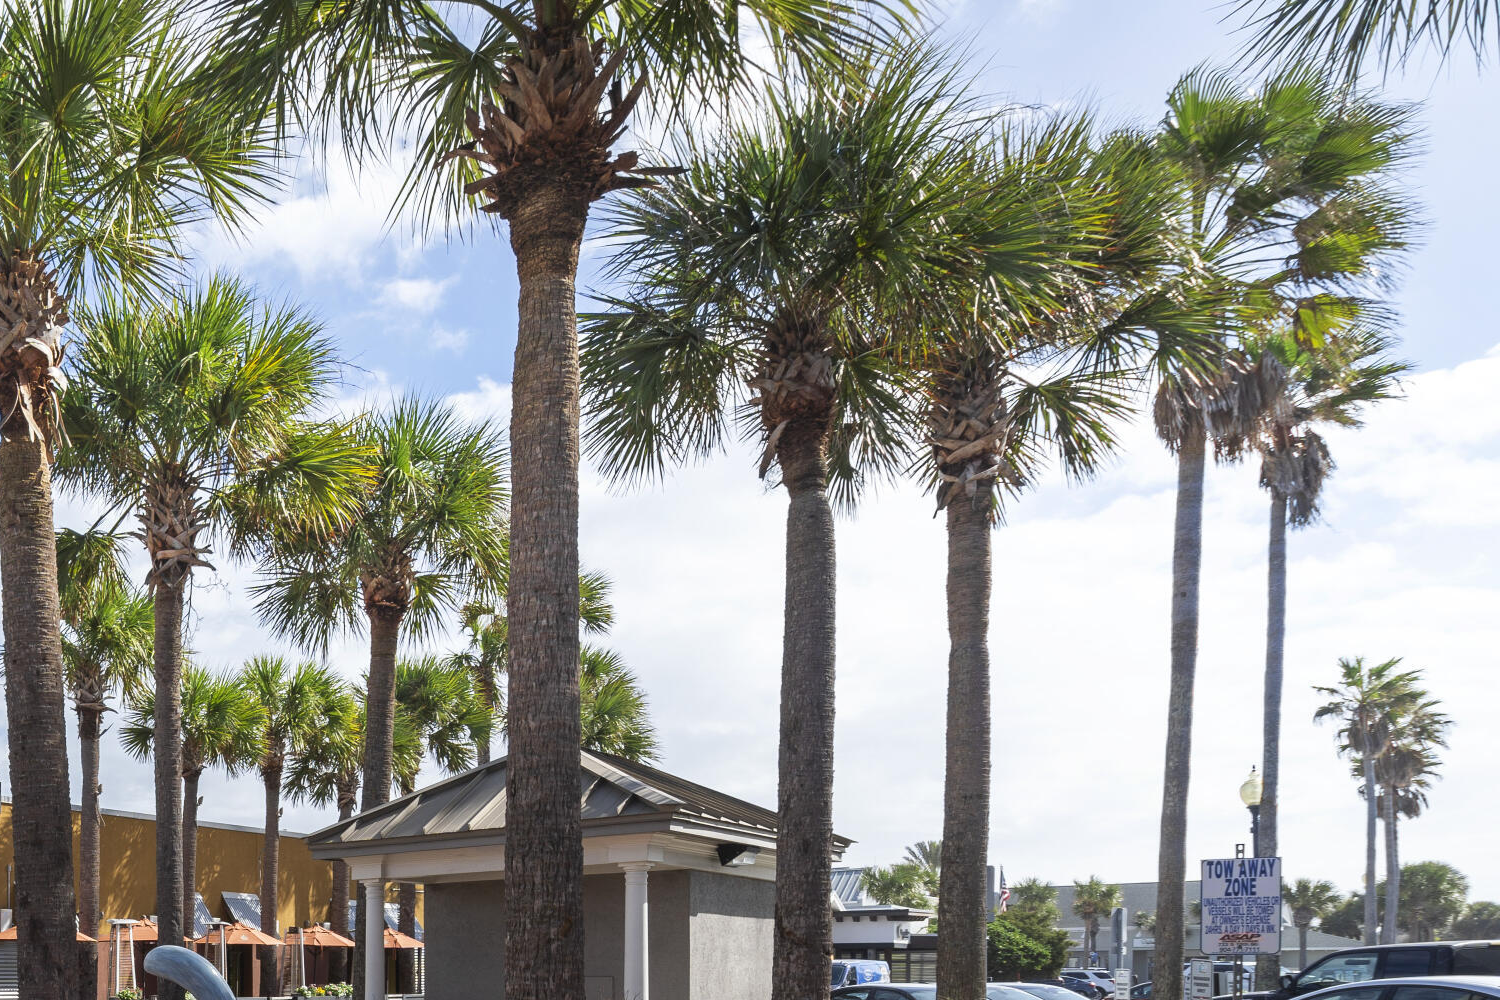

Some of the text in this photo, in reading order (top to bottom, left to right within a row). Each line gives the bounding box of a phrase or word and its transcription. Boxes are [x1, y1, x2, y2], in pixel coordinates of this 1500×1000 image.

[1206, 859, 1275, 879] TOW AWAY
[1225, 878, 1256, 896] ZONE
[1203, 896, 1279, 907] UNAUTHORIZED VEHICLES OR
[1208, 905, 1275, 916] VESSELS WILL BE TOWED
[1211, 915, 1219, 925] AT
[1246, 915, 1271, 925] EXPENSE
[1229, 925, 1240, 934] DAY
[1246, 924, 1260, 934] DAYS
[1219, 933, 1262, 941] ASAP
